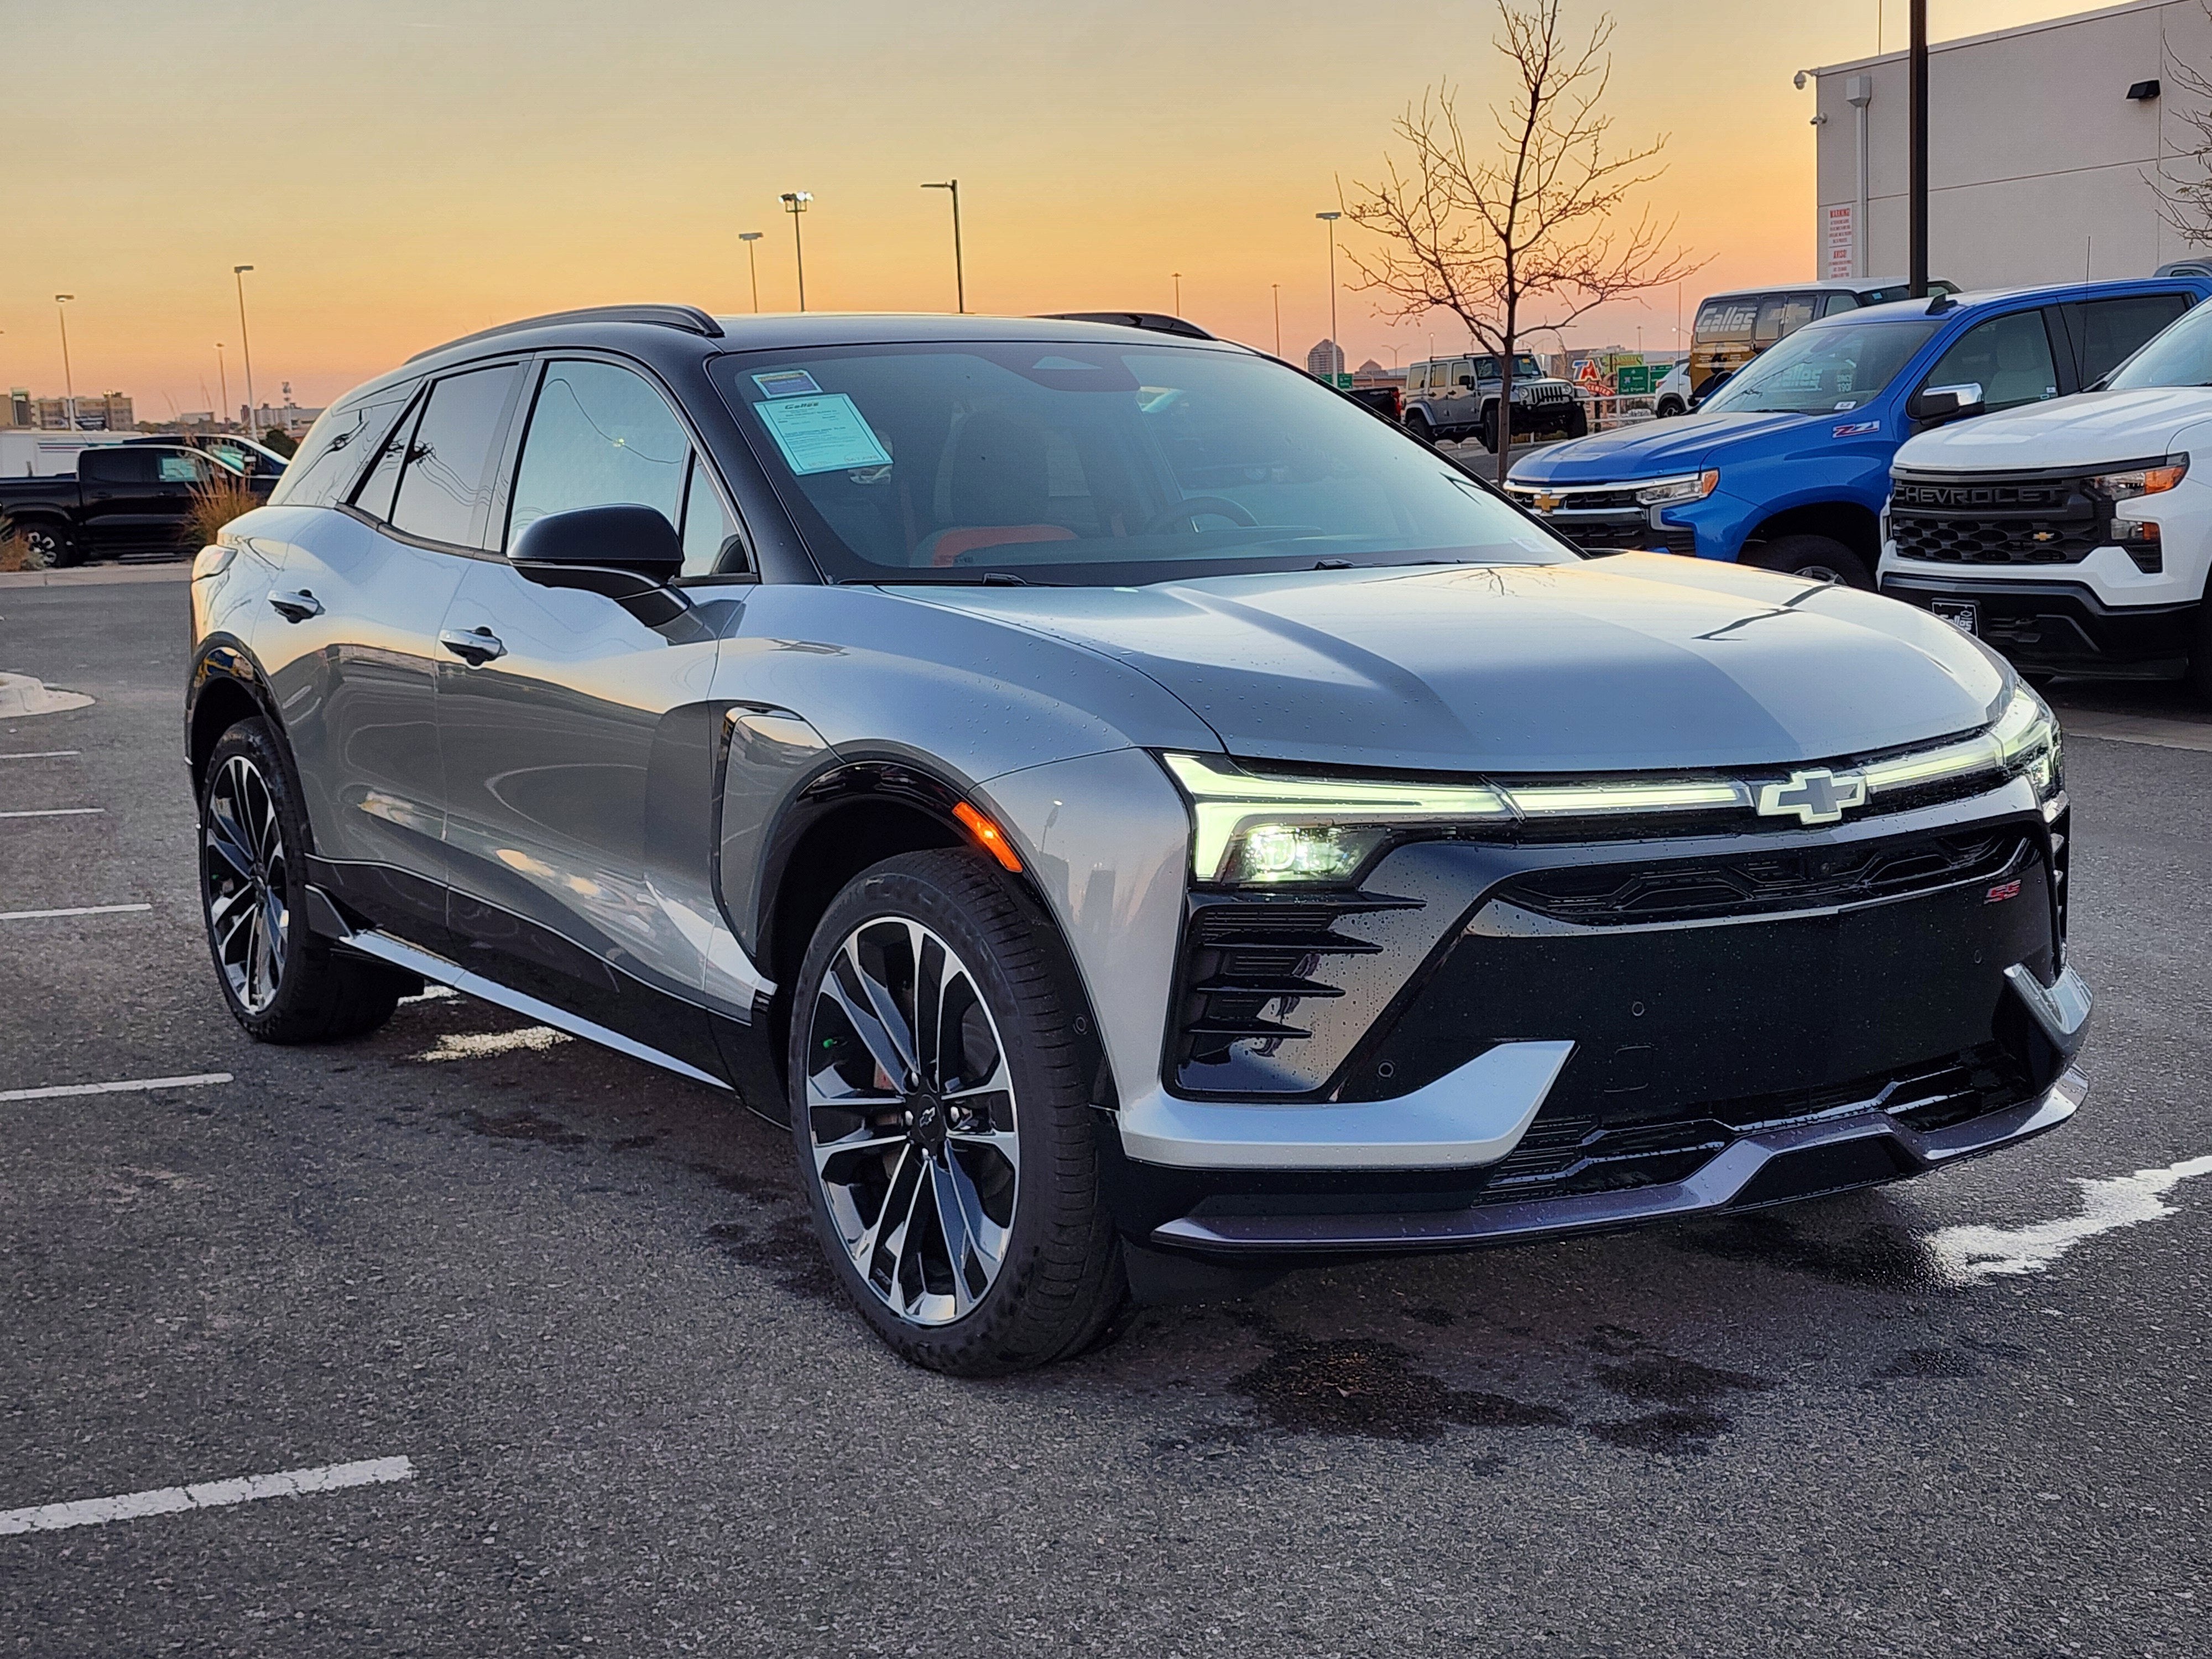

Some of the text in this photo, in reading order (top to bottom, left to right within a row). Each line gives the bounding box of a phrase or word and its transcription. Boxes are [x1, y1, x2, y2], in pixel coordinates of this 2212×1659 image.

[1695, 306, 1757, 332] Galles
[1832, 420, 1880, 439] Z71
[1893, 486, 2064, 504] CHEVROLET
[1984, 879, 2021, 904] SS
